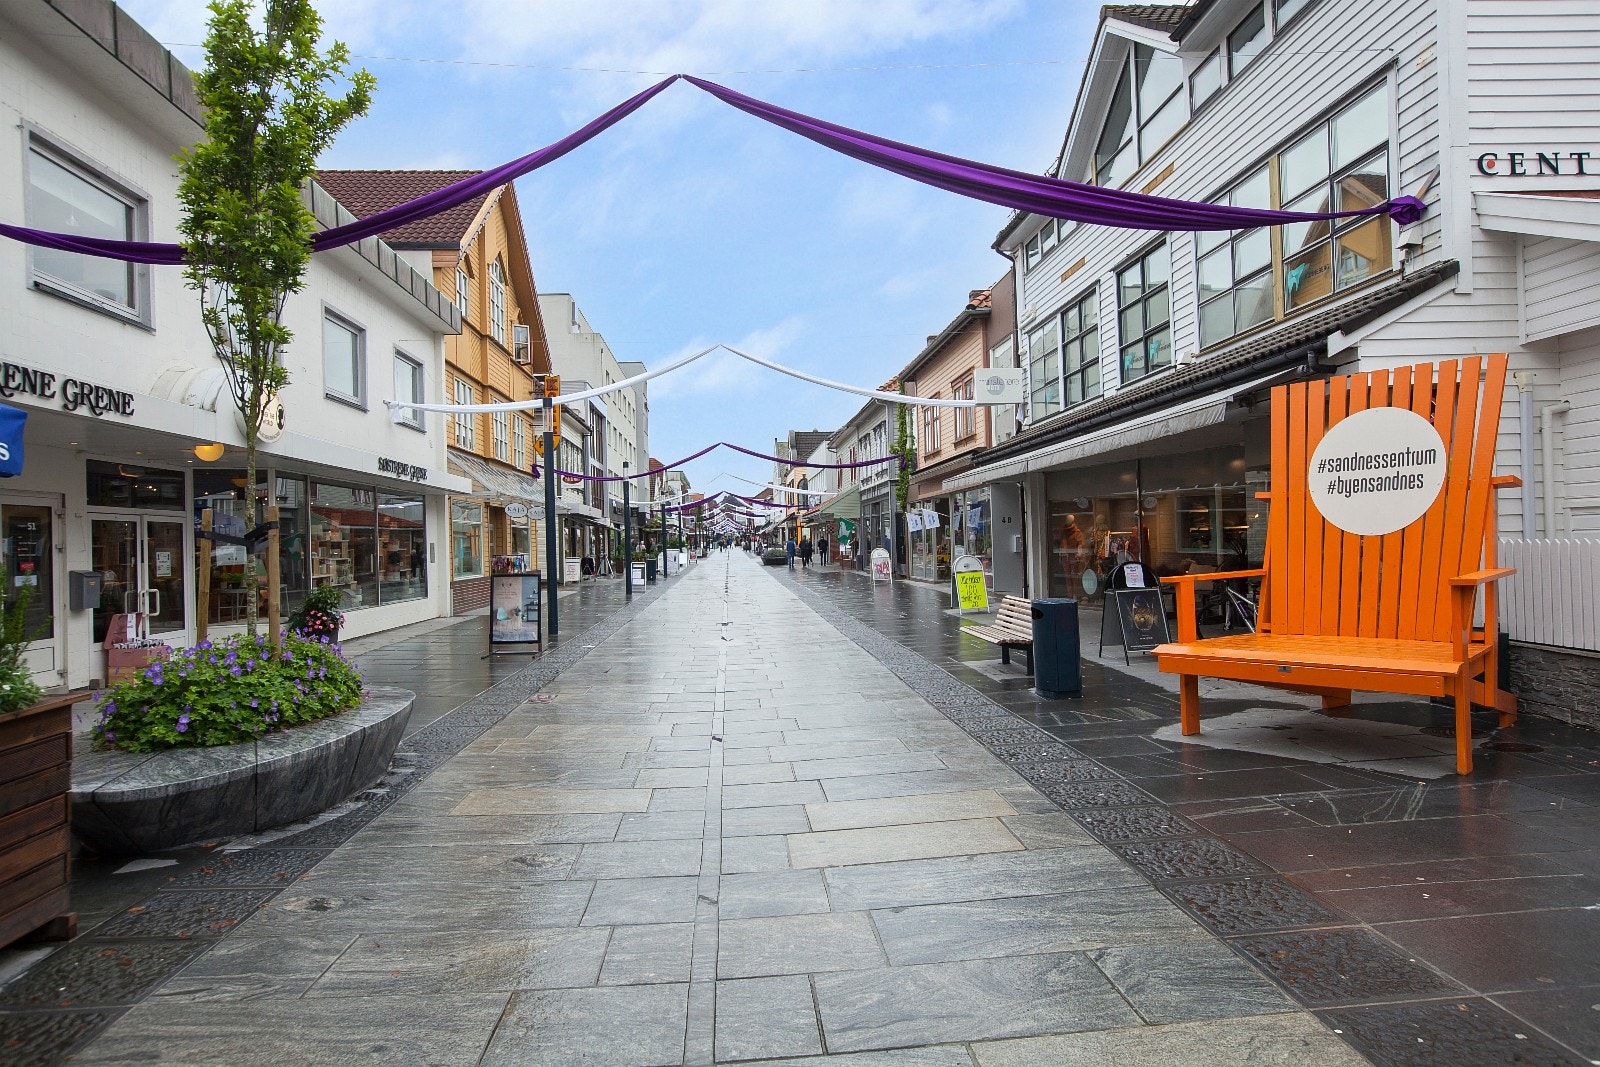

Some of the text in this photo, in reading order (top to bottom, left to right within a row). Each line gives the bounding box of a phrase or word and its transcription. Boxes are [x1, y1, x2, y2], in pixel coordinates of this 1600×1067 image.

[1477, 152, 1591, 176] CENT
[62, 378, 135, 416] GRENE
[1317, 446, 1437, 474] #sandnessentrum
[1327, 470, 1424, 498] #byensandnes
[27, 522, 37, 531] 51
